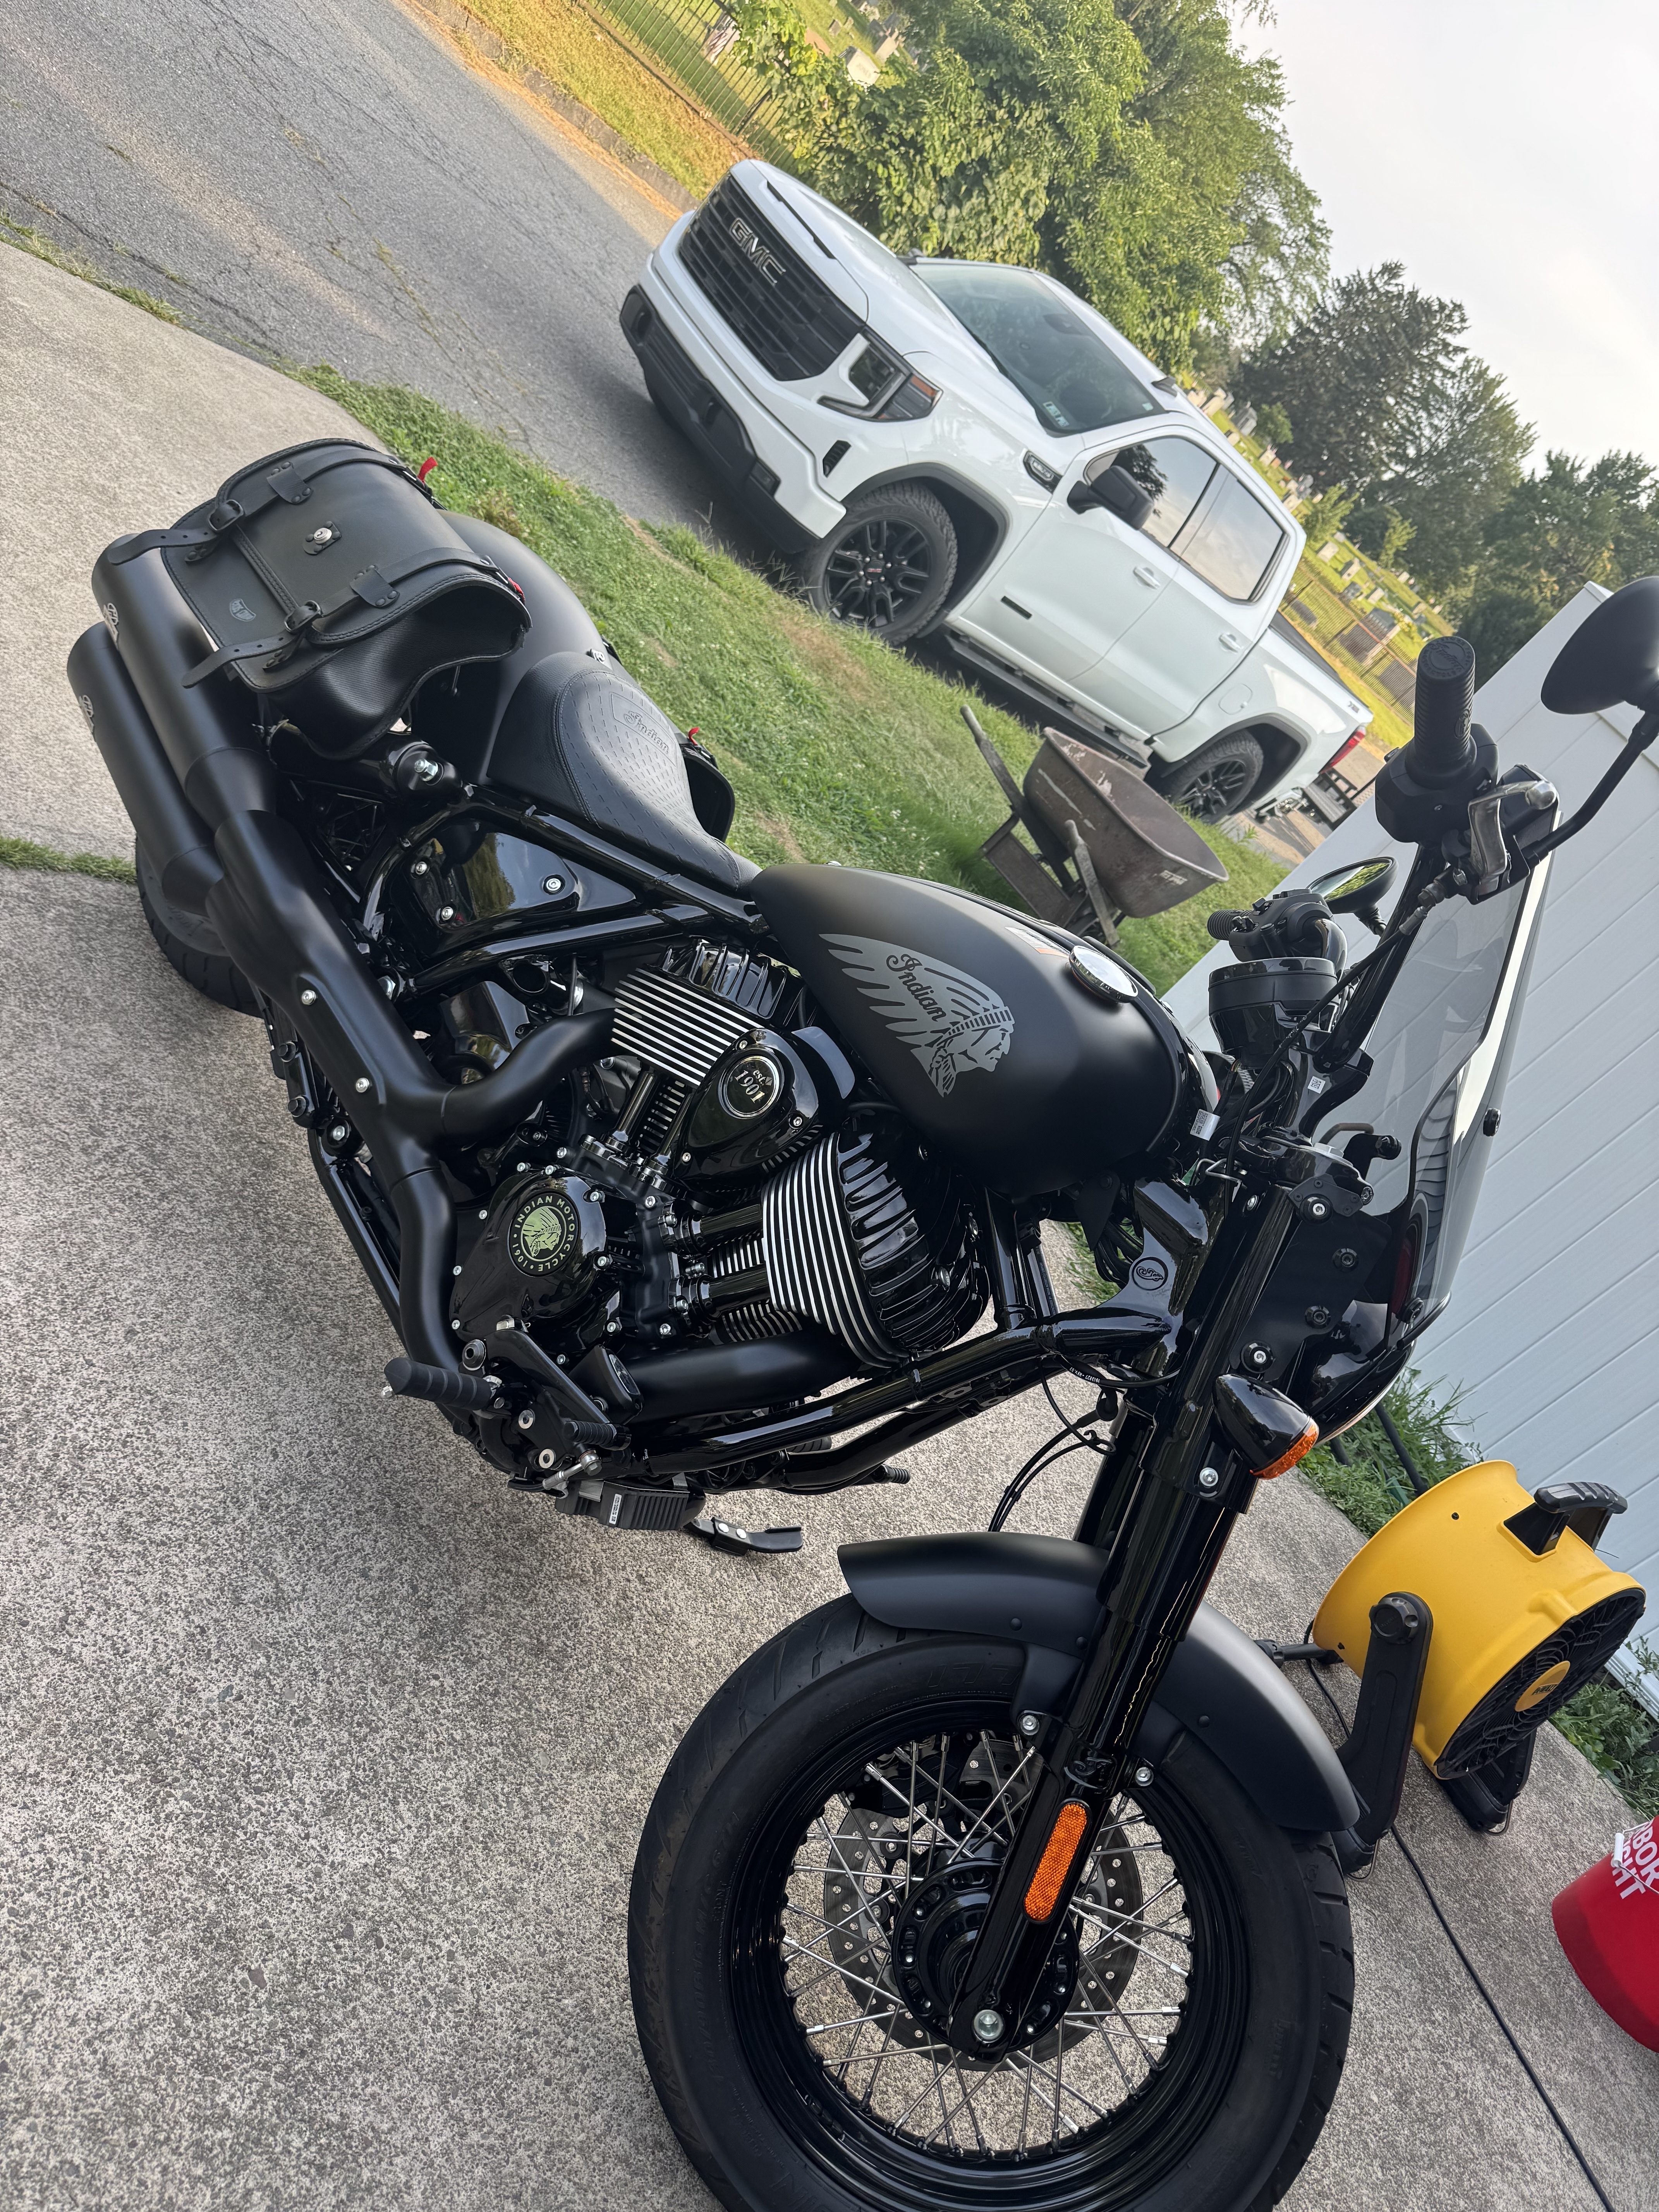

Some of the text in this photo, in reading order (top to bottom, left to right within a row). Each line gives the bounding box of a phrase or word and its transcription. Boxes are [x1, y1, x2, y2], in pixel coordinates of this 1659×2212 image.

[729, 217, 786, 286] GMC
[623, 711, 670, 754] Indian
[886, 953, 947, 1022] Indian
[734, 1070, 766, 1104] 1901
[752, 1070, 766, 1084] est.
[512, 1243, 528, 1267] 1901
[514, 1195, 575, 1272] INDIAN MOTORCYCLE
